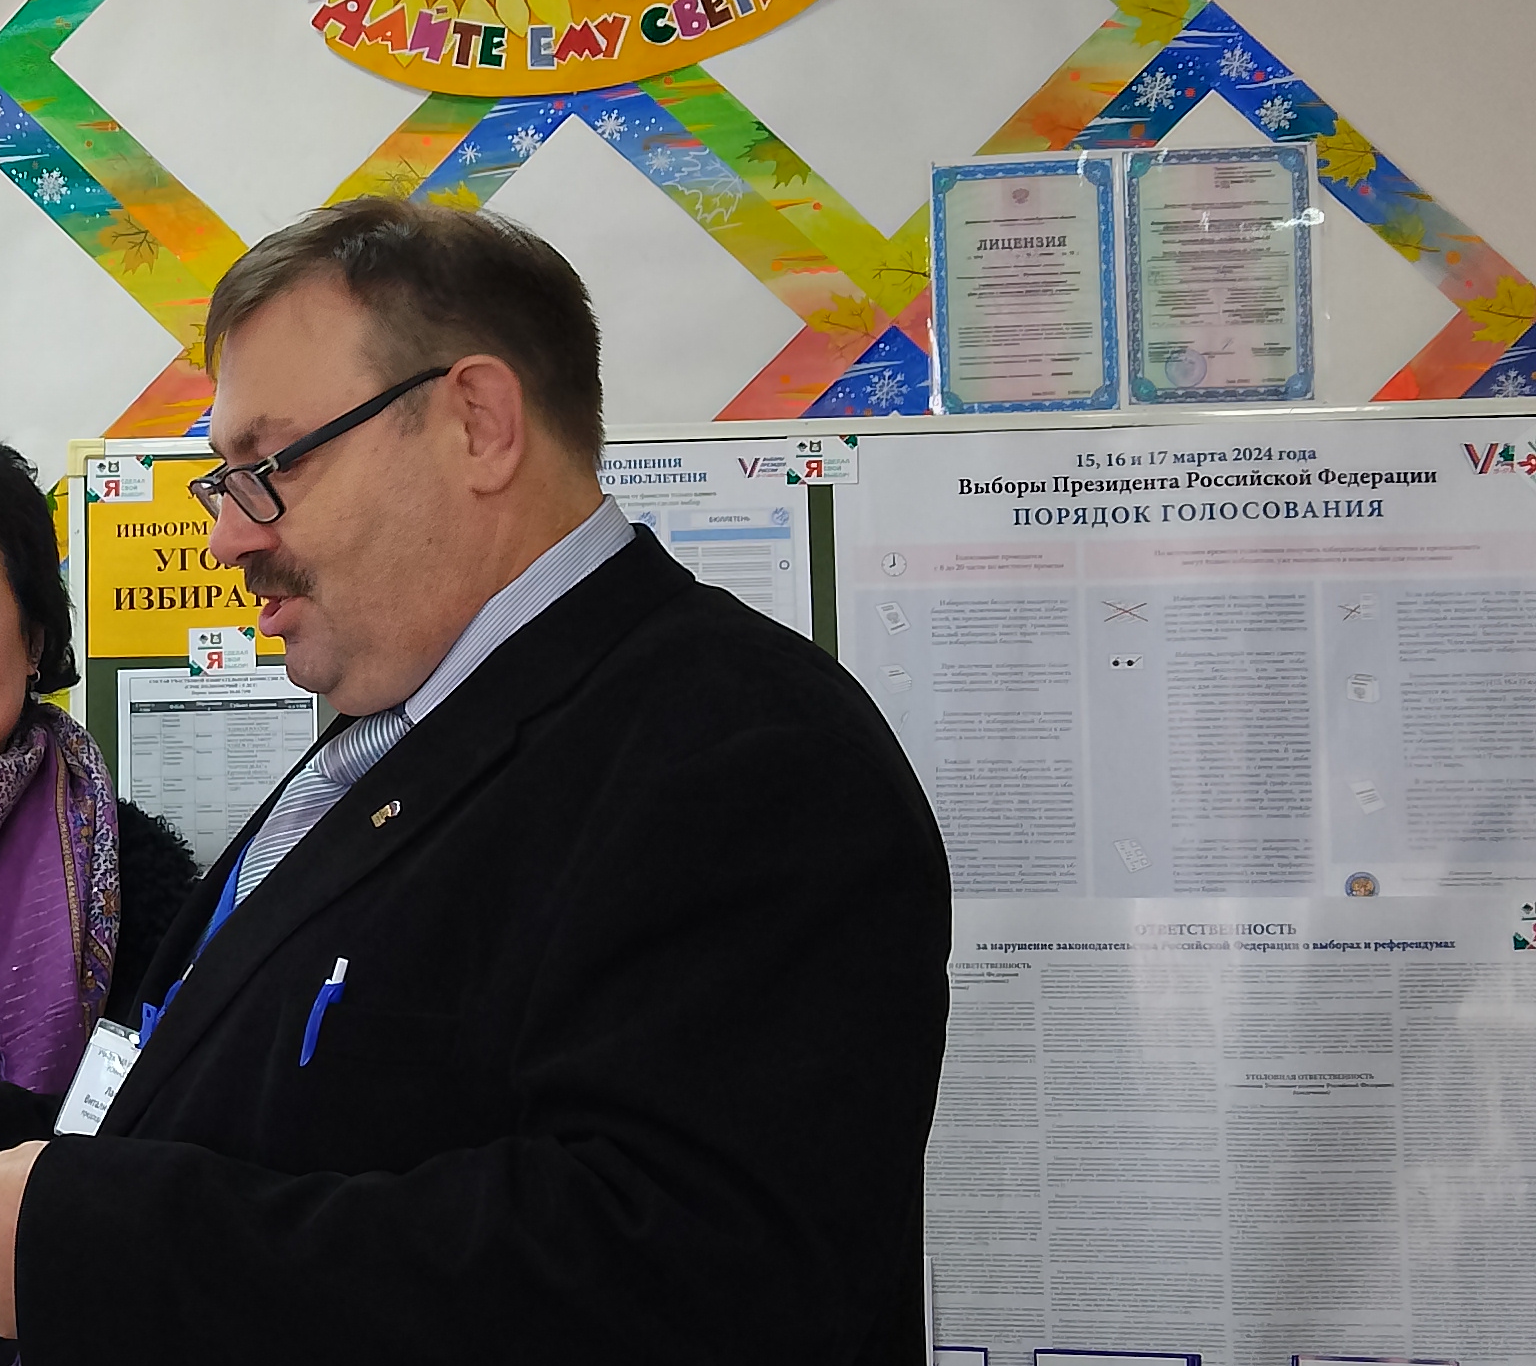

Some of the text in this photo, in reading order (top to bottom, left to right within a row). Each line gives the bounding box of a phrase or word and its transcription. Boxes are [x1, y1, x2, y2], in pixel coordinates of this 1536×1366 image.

[528, 13, 631, 69] ЕМУ
[977, 235, 1067, 251] ЛИЦЕНЗИЯ
[601, 458, 682, 470] ПОЛНЕНИЯ
[1076, 447, 1317, 469] 15, 16 и 17 марта 2024 года
[805, 460, 822, 477] Я
[620, 472, 707, 485] БЮЛЛЕТЕНЯ
[958, 468, 1438, 498] Выборы Президента Российской Федерации
[104, 480, 120, 497] Я
[1013, 500, 1384, 528] ПОРЯДОК ГОЛОСОВАНИЯ
[116, 521, 208, 538] ИНФОРМ
[153, 547, 243, 572] УГО
[207, 651, 223, 669] Я
[976, 942, 988, 950] за
[990, 941, 1053, 953] нарушение
[1312, 940, 1362, 952] выборах
[1374, 939, 1455, 952] референдумах
